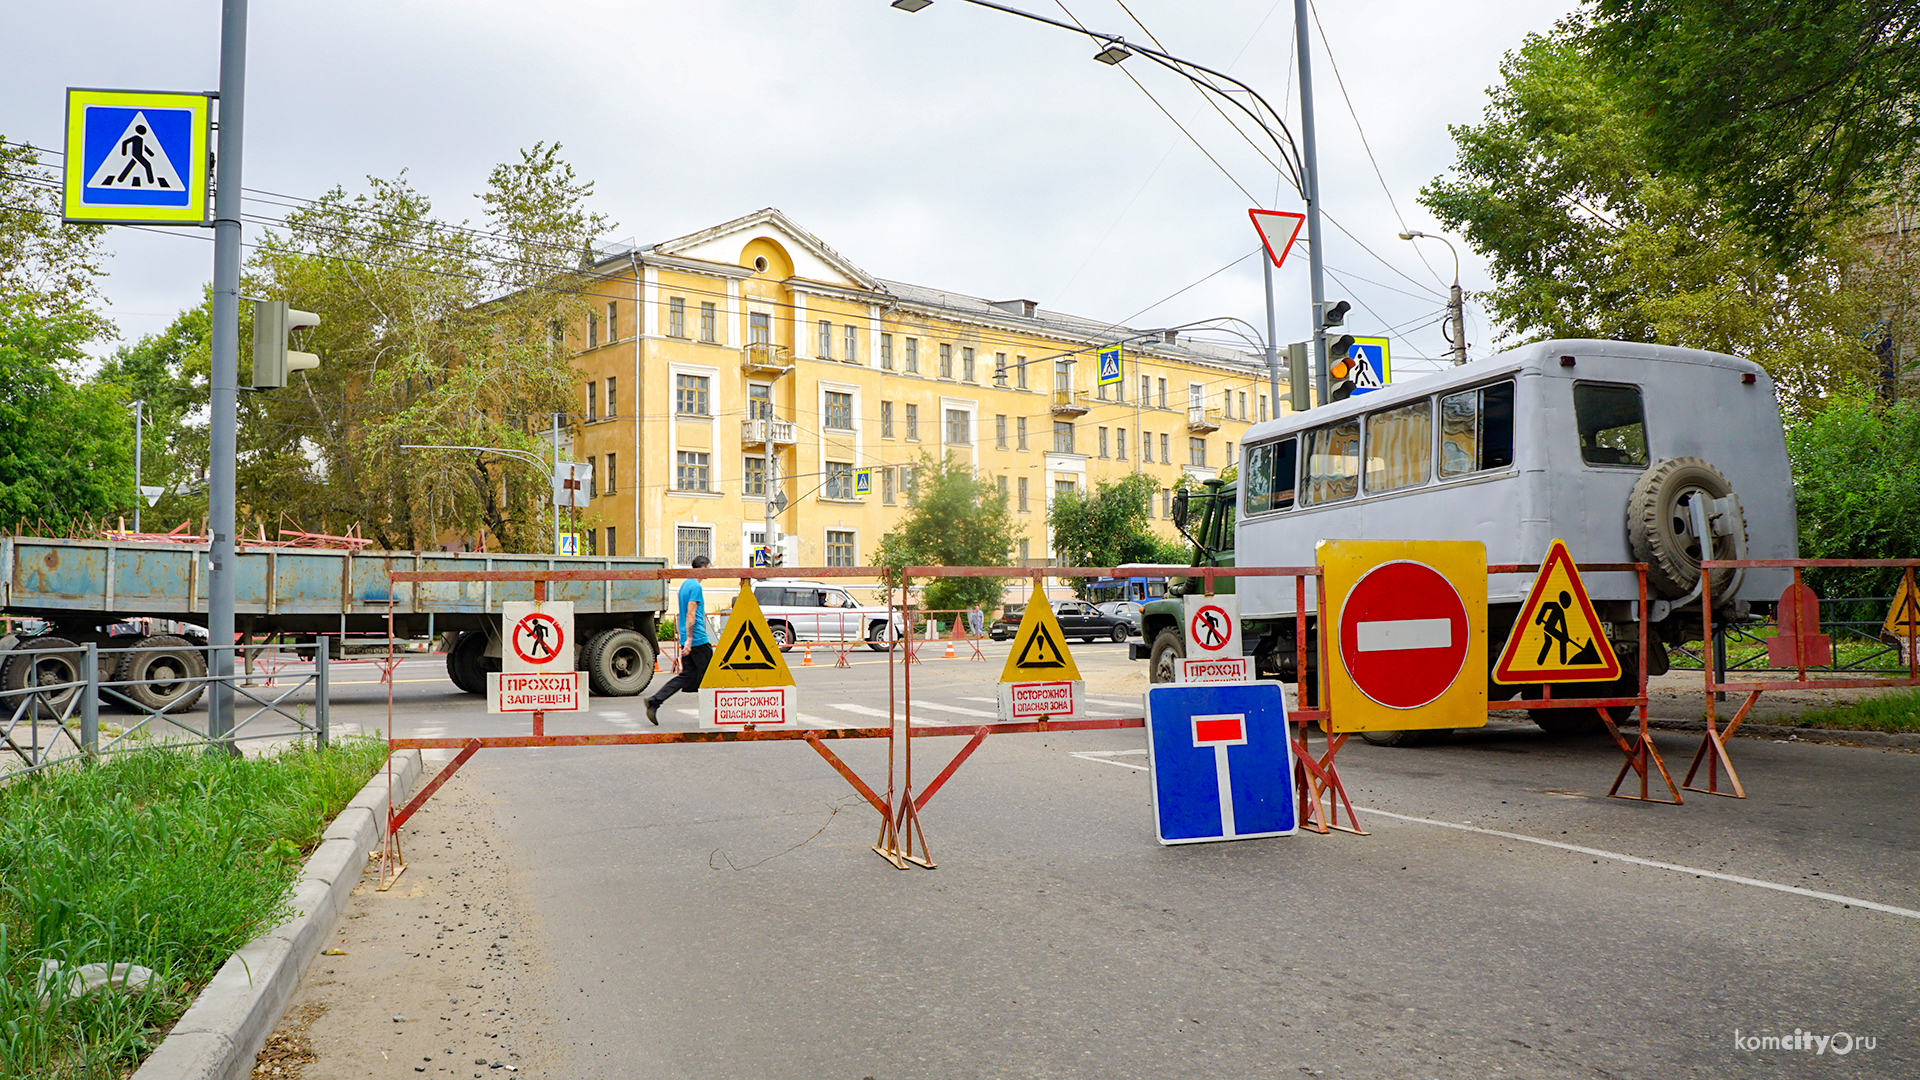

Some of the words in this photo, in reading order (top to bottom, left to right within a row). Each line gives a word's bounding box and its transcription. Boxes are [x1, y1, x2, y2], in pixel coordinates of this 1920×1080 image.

[1190, 664, 1241, 677] ПРОХОД
[507, 678, 571, 692] ПРОХОД
[507, 694, 571, 705] ЗАПРЕЩЕН
[1016, 688, 1068, 701] ОСТОРОЖНО!
[720, 696, 779, 707] ОСТОРОЖНО!
[1017, 702, 1049, 712] ОПАСНАЯ
[1049, 700, 1068, 711] ЗОНА
[720, 709, 757, 719] ОПАСНАЯ
[758, 709, 779, 719] ЗОНА
